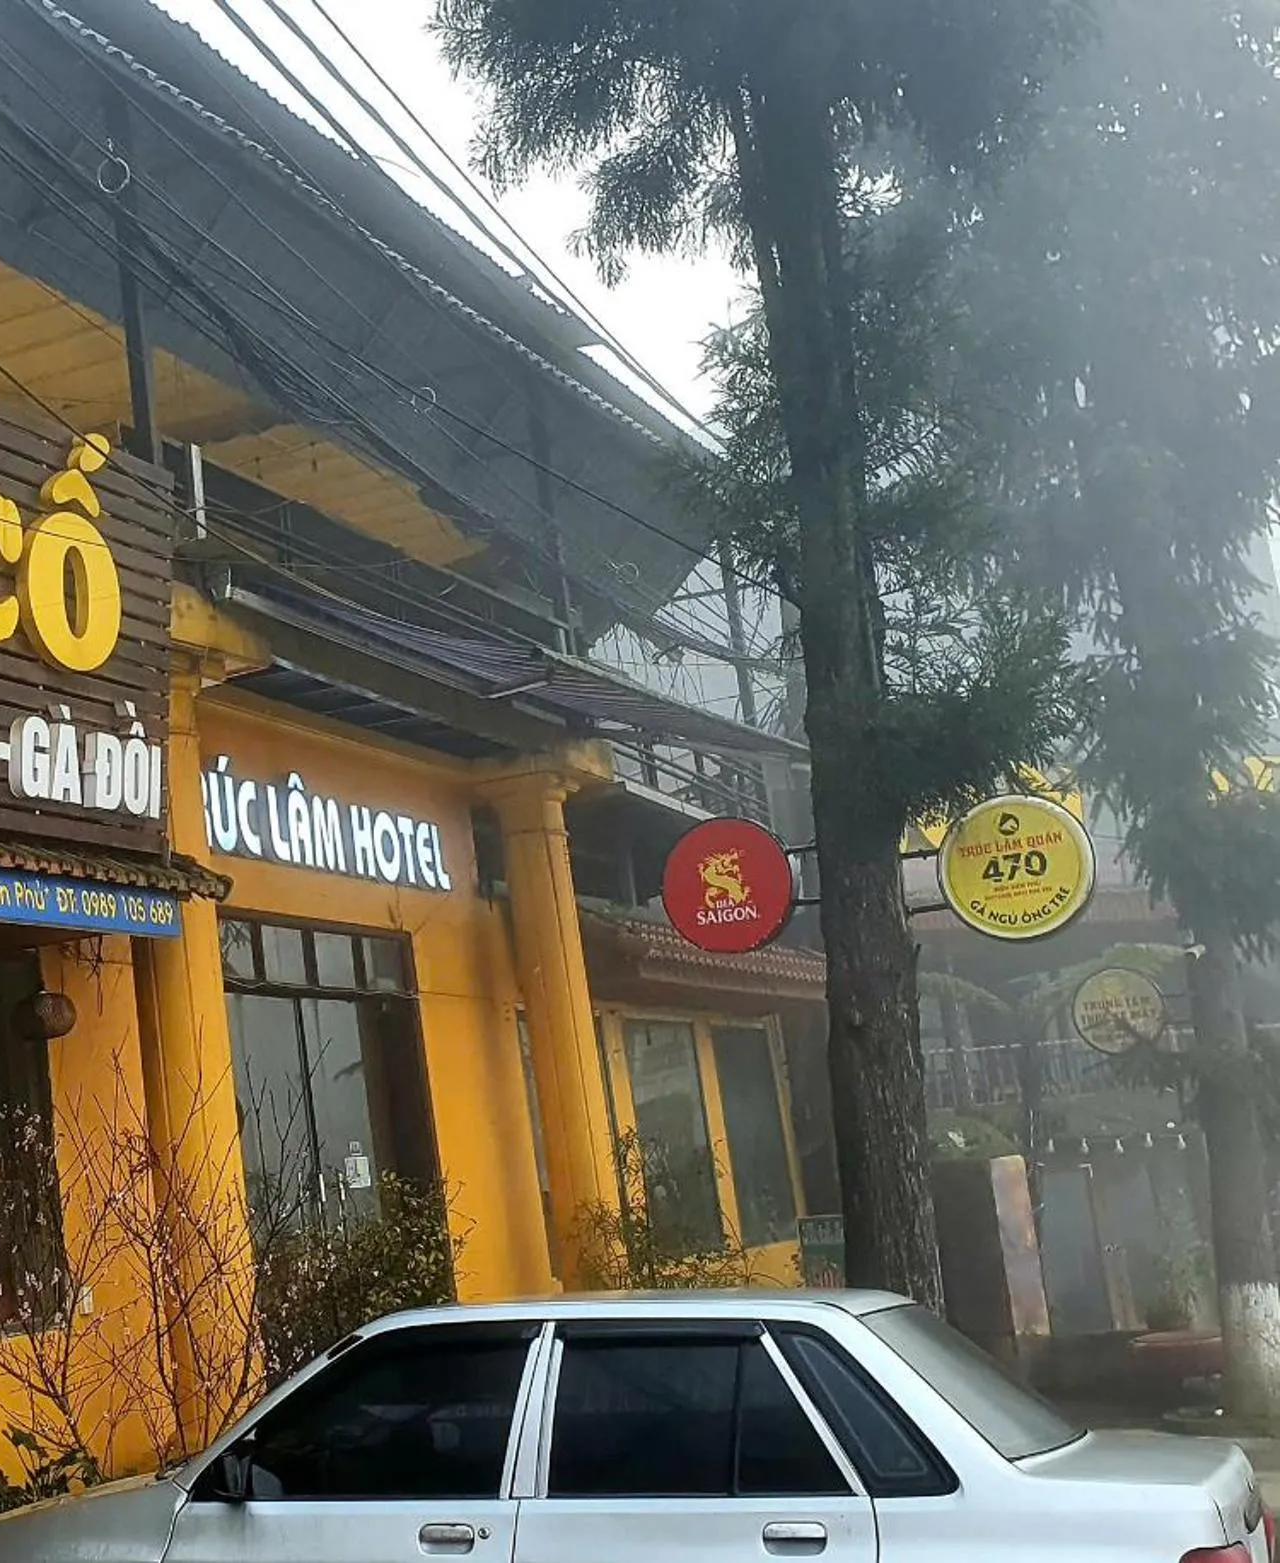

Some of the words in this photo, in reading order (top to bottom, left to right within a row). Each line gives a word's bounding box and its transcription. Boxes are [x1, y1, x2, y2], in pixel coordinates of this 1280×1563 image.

[9, 703, 84, 808] GÀ
[82, 699, 161, 820] ĐỒI
[200, 755, 262, 855] ÚC
[267, 772, 347, 873] LÂM
[350, 804, 452, 890] HOTEL
[982, 850, 1048, 883] 470
[81, 890, 117, 920] 0989
[121, 895, 147, 923] 105
[149, 899, 174, 926] 689
[696, 905, 757, 925] SAIGON
